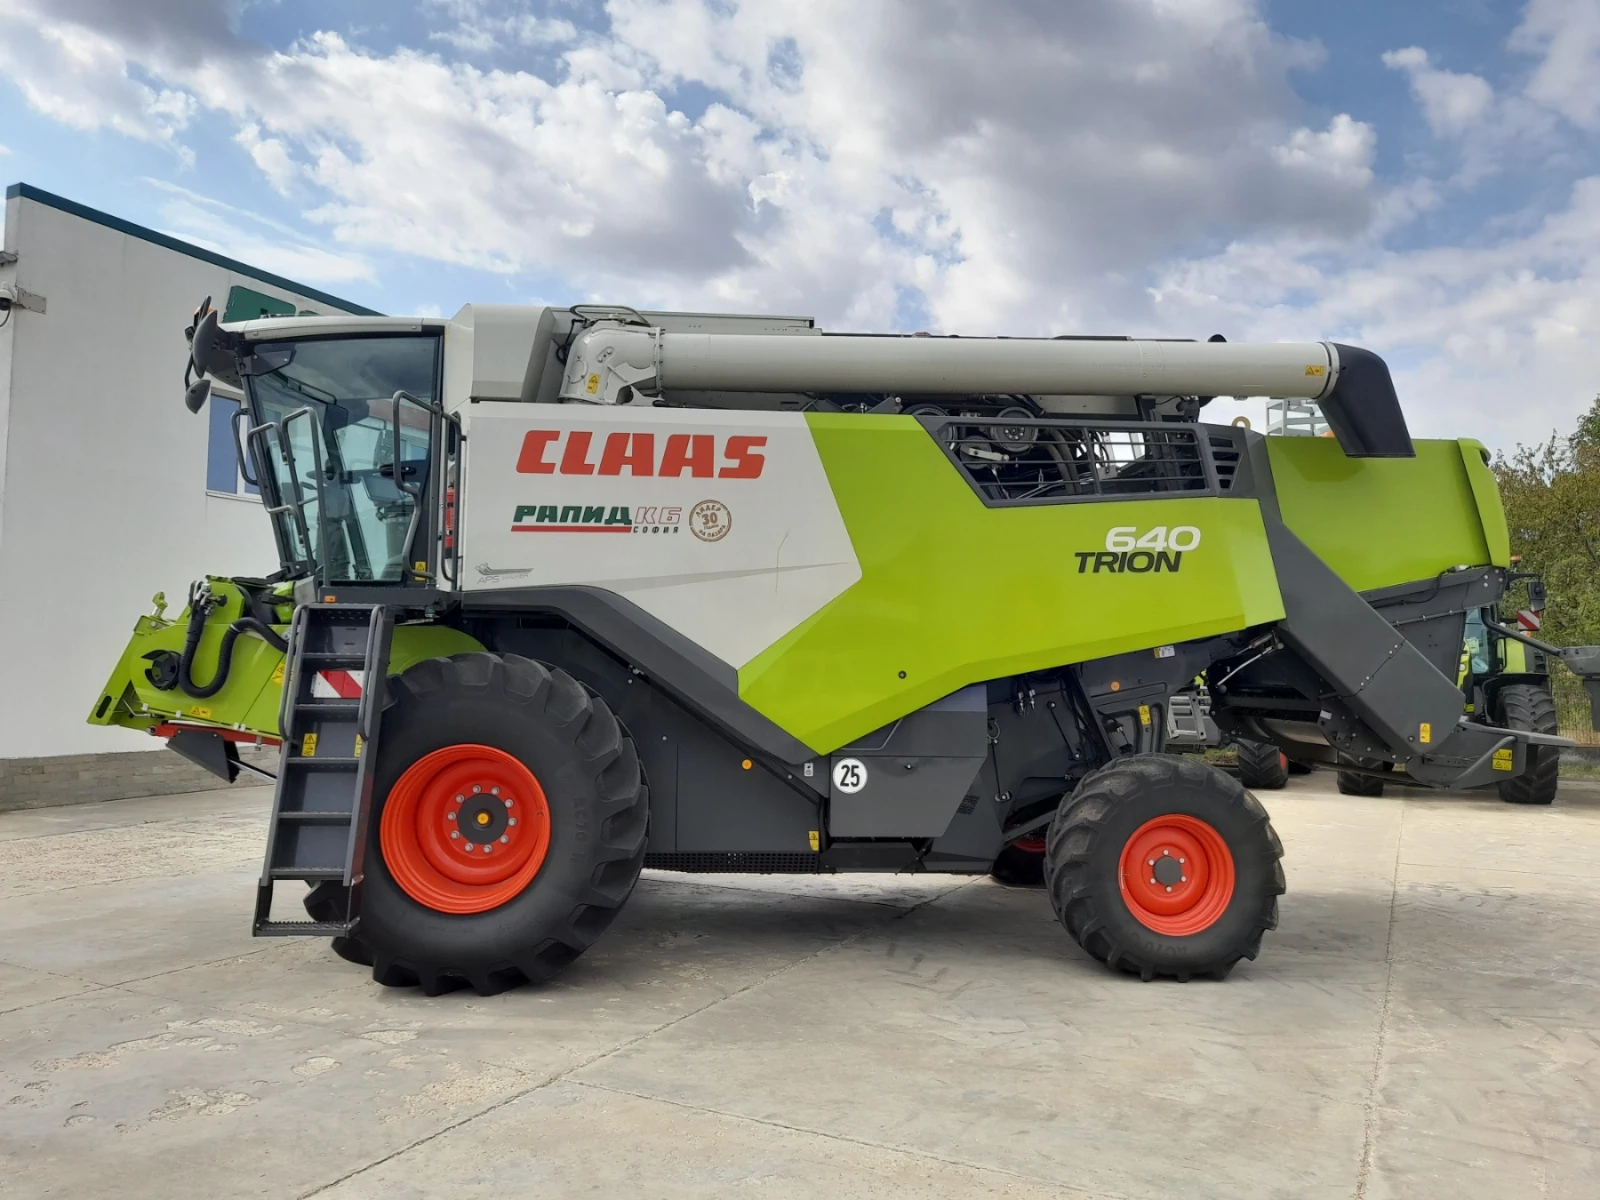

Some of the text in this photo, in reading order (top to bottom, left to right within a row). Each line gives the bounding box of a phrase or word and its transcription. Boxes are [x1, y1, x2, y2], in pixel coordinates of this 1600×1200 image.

[515, 429, 768, 479] CLAAS
[633, 526, 679, 534] СОФИЯ
[701, 511, 718, 526] 30
[1105, 525, 1201, 552] 640
[1074, 550, 1182, 573] TRION
[839, 764, 861, 788] 25
